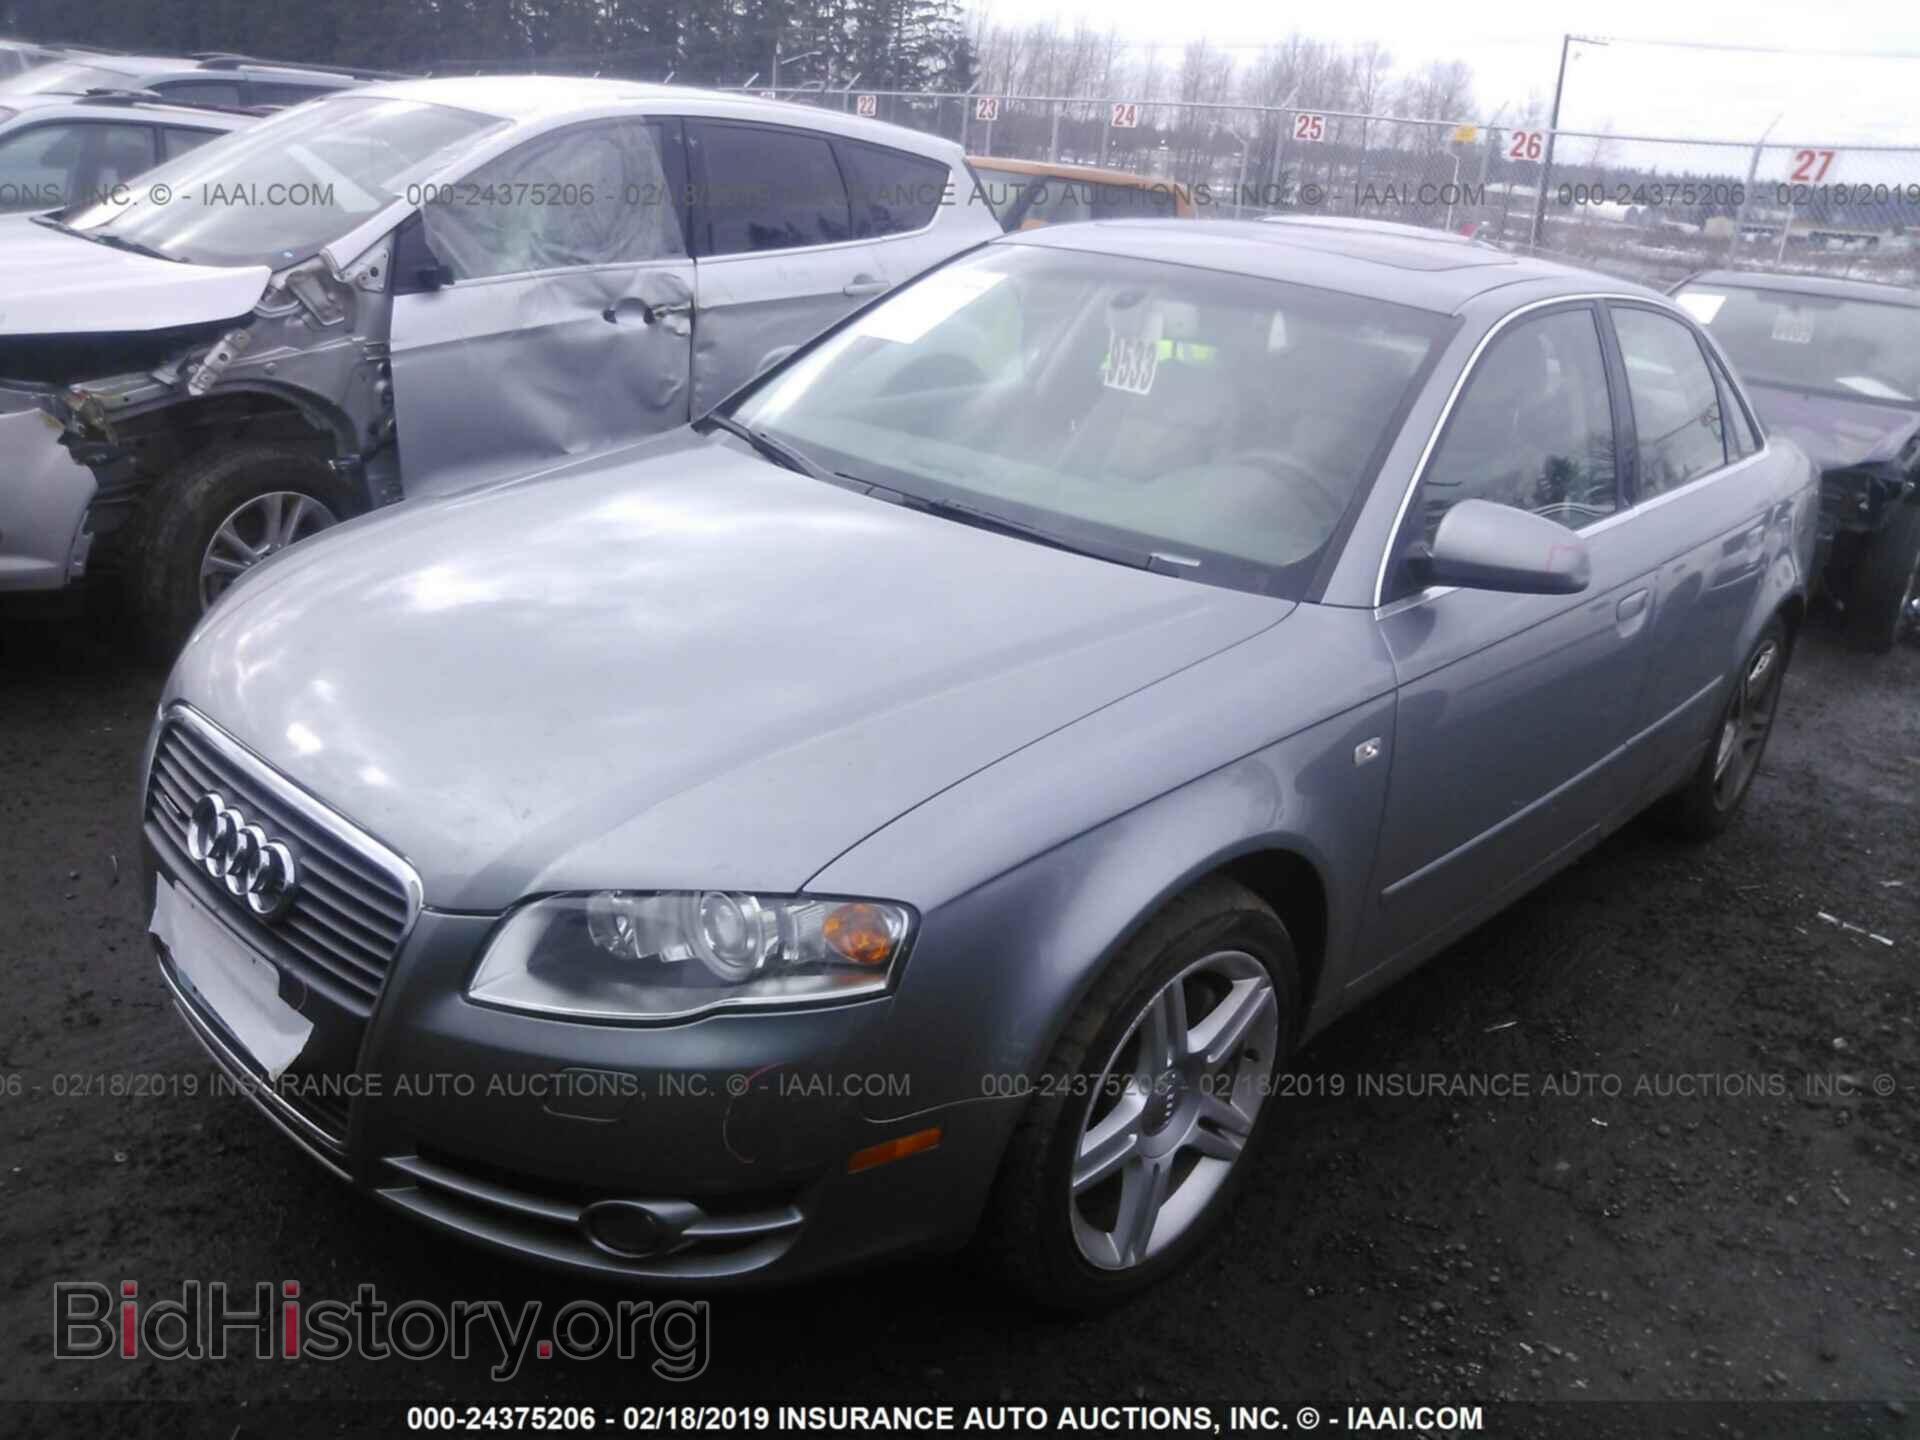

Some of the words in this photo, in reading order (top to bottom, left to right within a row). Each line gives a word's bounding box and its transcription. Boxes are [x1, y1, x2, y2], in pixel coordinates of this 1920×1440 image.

[858, 97, 875, 114] 22
[978, 100, 996, 119] 23
[1114, 104, 1136, 126] 24
[1296, 115, 1322, 140] 25
[1510, 131, 1541, 158] 26
[1791, 149, 1834, 182] 27
